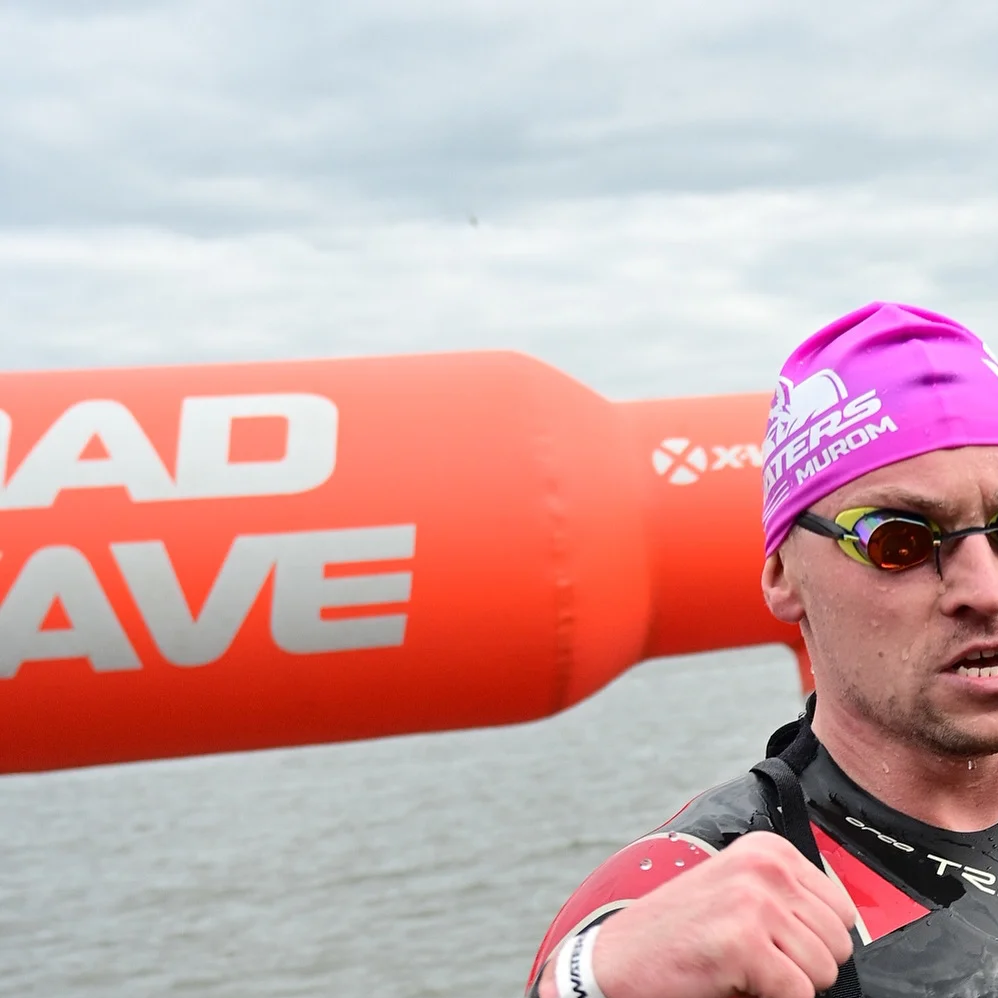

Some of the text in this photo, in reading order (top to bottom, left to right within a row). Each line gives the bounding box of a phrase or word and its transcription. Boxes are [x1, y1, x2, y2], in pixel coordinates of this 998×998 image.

[0, 392, 339, 511] AD
[795, 415, 899, 486] MUROM
[0, 523, 416, 679] AVE
[845, 816, 915, 853] orca
